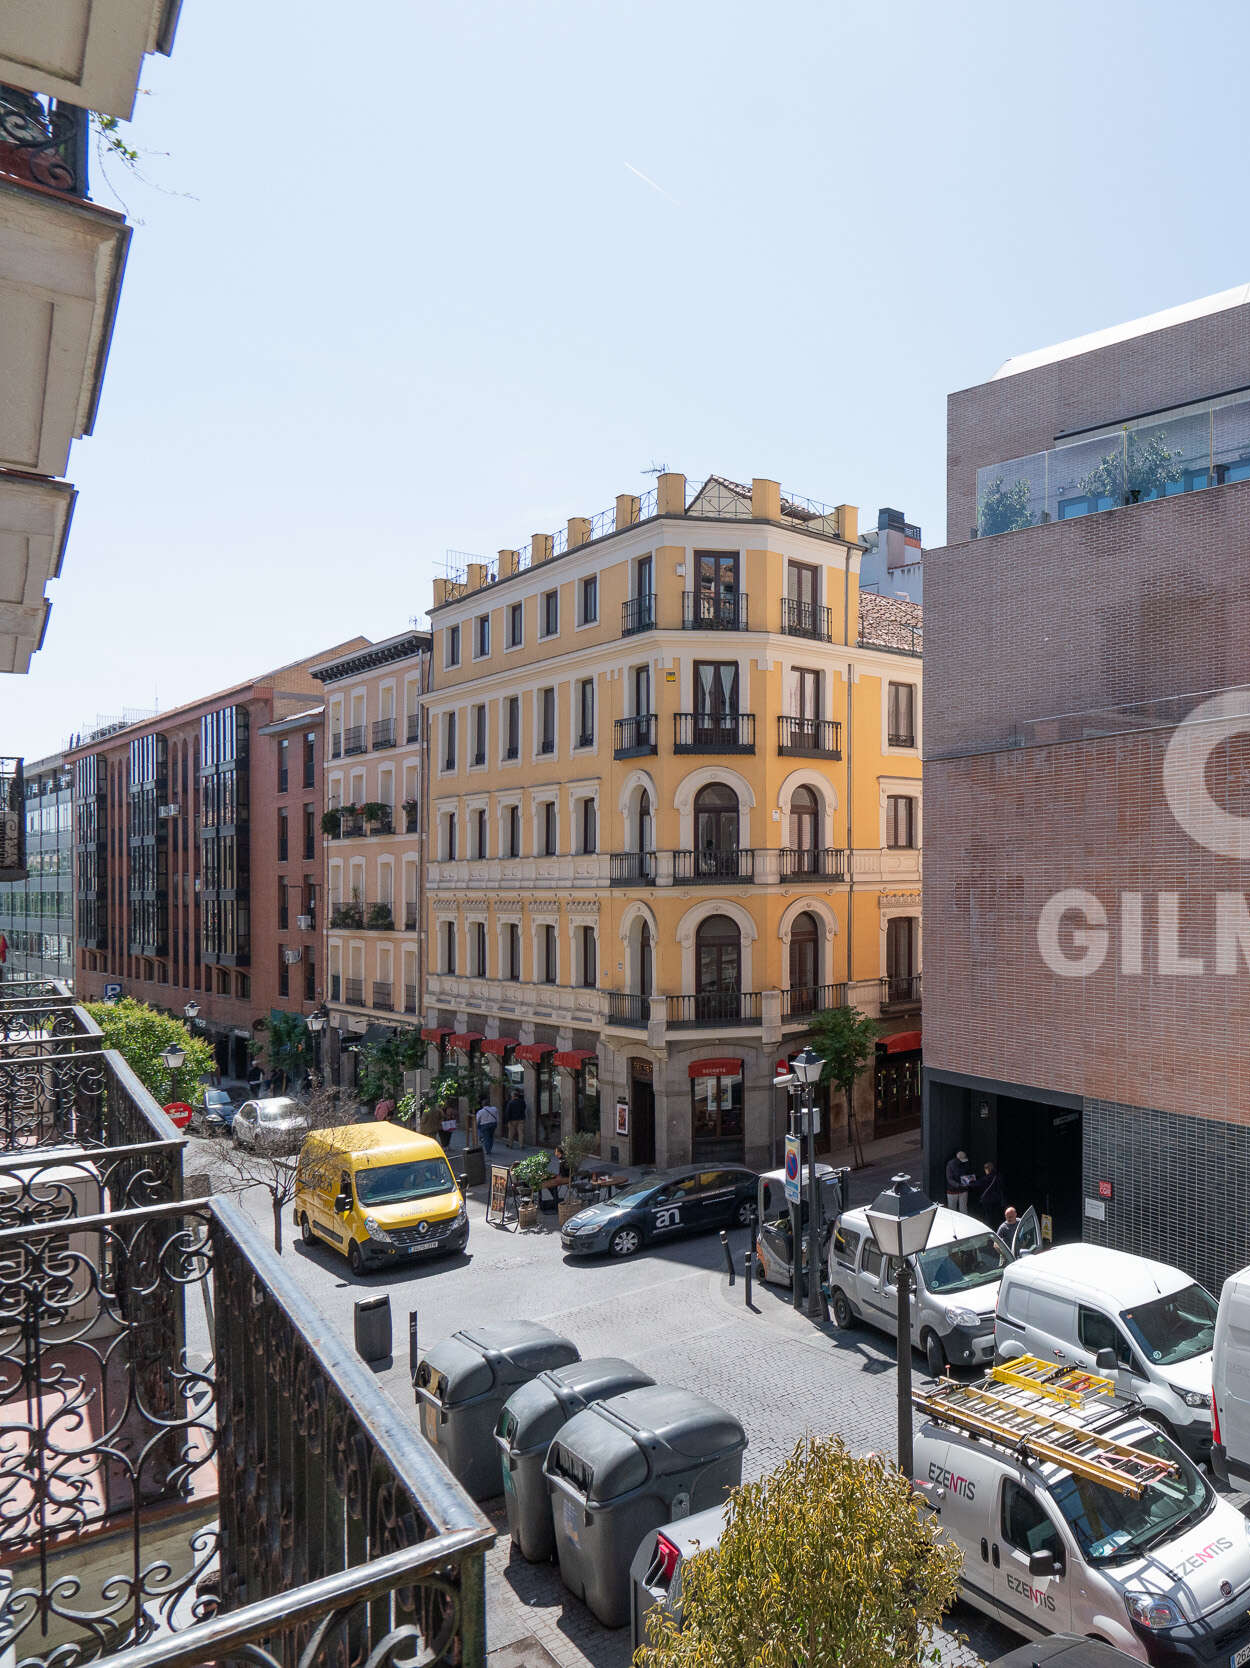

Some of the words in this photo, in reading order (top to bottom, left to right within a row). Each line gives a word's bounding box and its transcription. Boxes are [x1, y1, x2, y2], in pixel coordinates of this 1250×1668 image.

[107, 985, 120, 997] P
[928, 1462, 976, 1501] EZENTIS
[1006, 1573, 1057, 1612] EZENTIS
